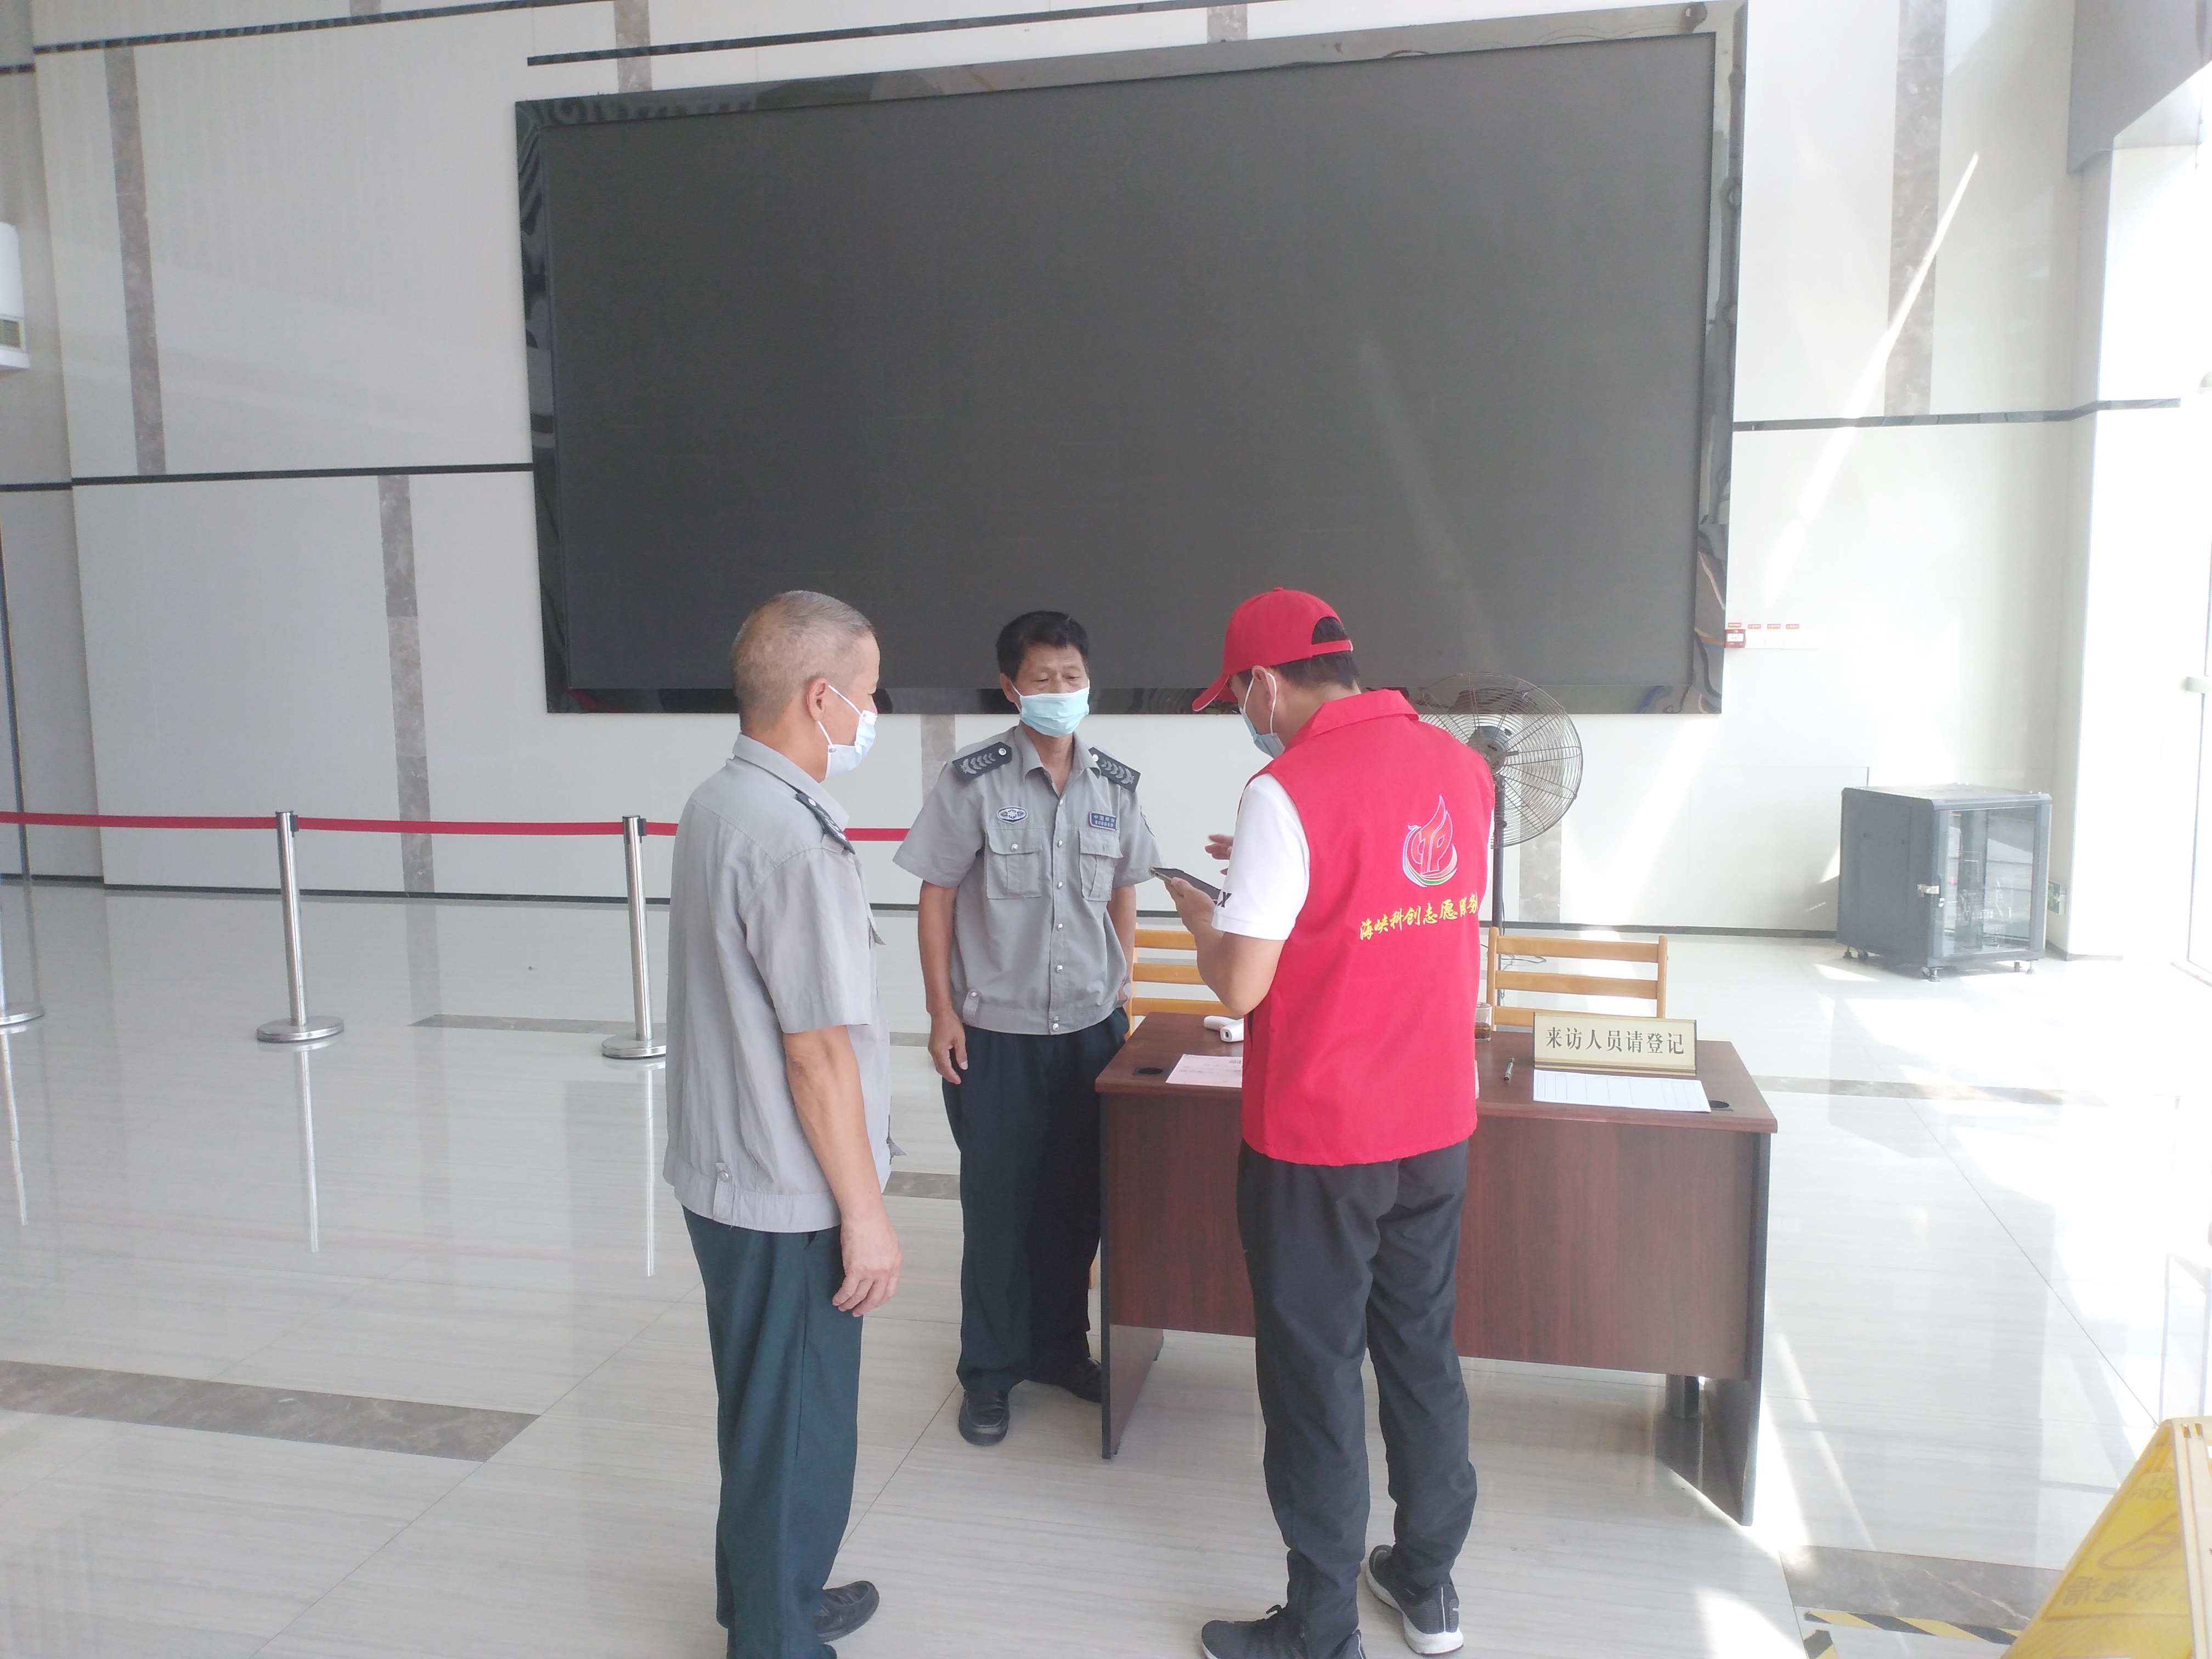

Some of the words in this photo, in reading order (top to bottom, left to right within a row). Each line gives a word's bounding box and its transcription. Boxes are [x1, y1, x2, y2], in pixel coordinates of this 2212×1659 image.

[1545, 1027, 1684, 1054] 来访人员请登记
